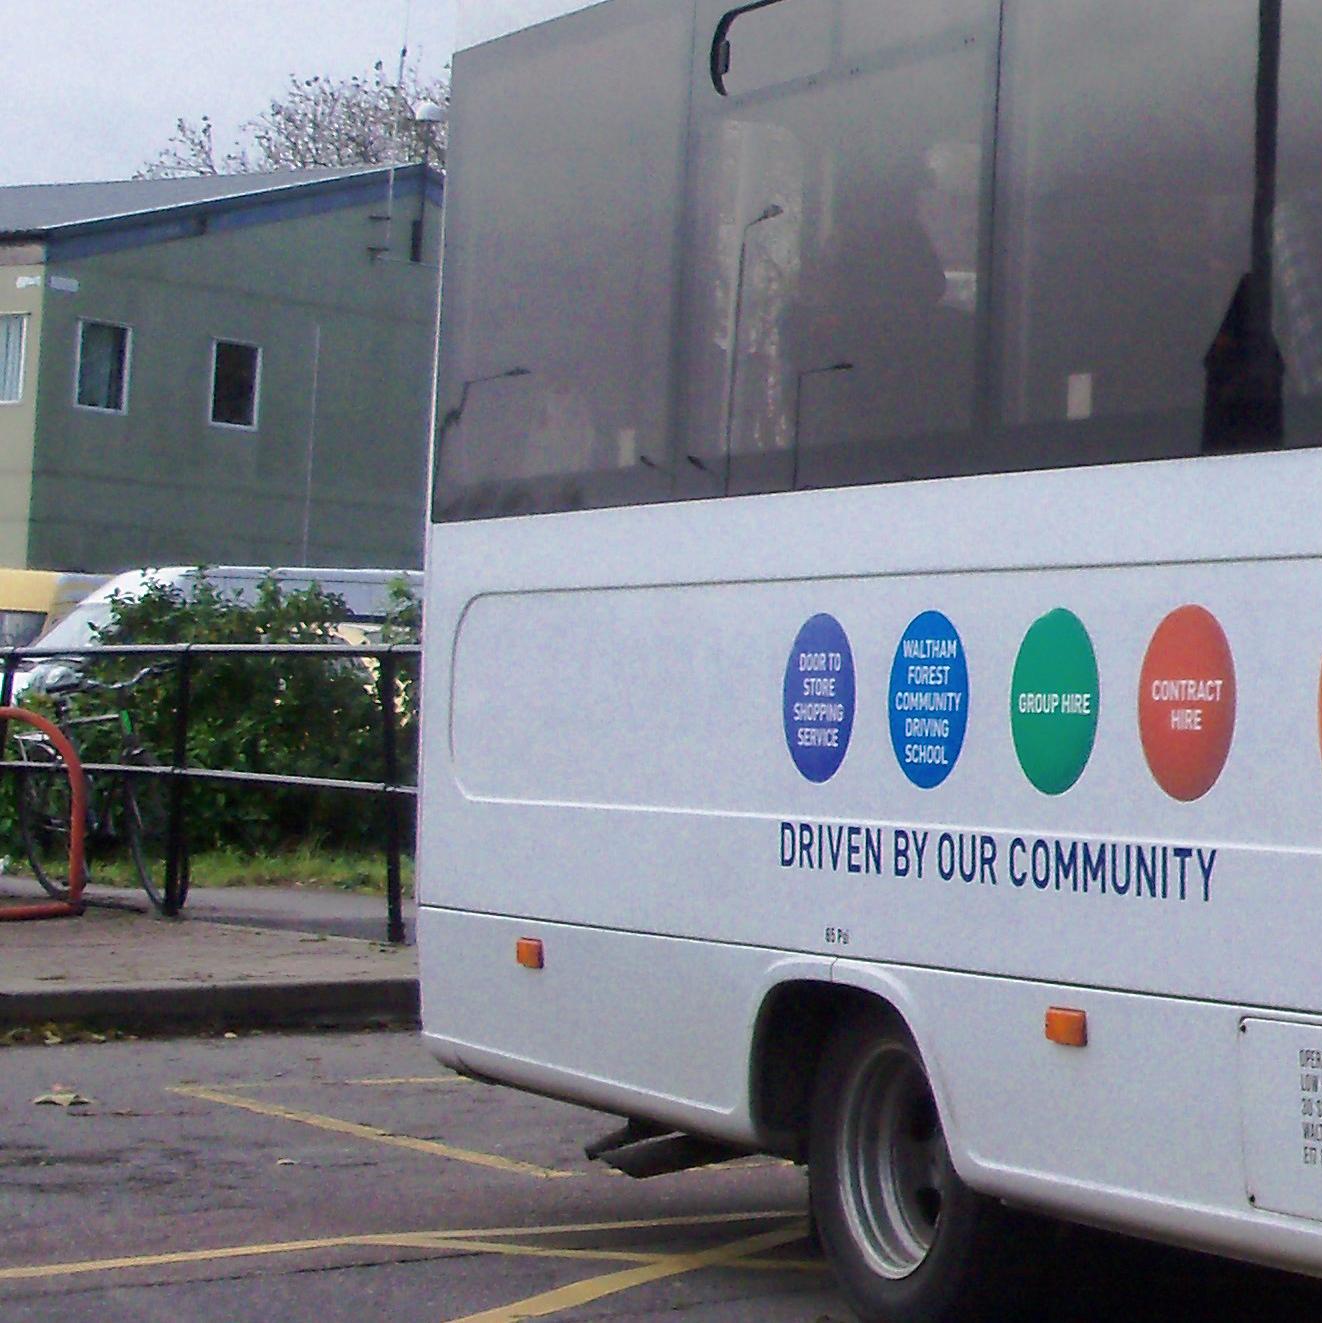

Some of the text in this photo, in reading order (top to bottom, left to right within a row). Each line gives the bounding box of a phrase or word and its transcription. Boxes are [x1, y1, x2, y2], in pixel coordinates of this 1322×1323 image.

[903, 639, 957, 660] WALTHAM
[799, 652, 842, 672] DOOR TO
[907, 665, 950, 685] FOREST
[803, 677, 836, 697] STORE
[1152, 678, 1223, 702] CONTRACT
[793, 702, 844, 724] SHOPPING
[895, 691, 961, 713] COMMUNITY
[1018, 692, 1091, 714] GROUP HIRE
[905, 717, 949, 738] DRIVING
[1171, 709, 1202, 731] HIRE
[797, 727, 839, 748] SERVICE
[905, 743, 948, 765] SCHOOL
[780, 821, 1217, 902] DRIVEN BY OUR COMMUNITY
